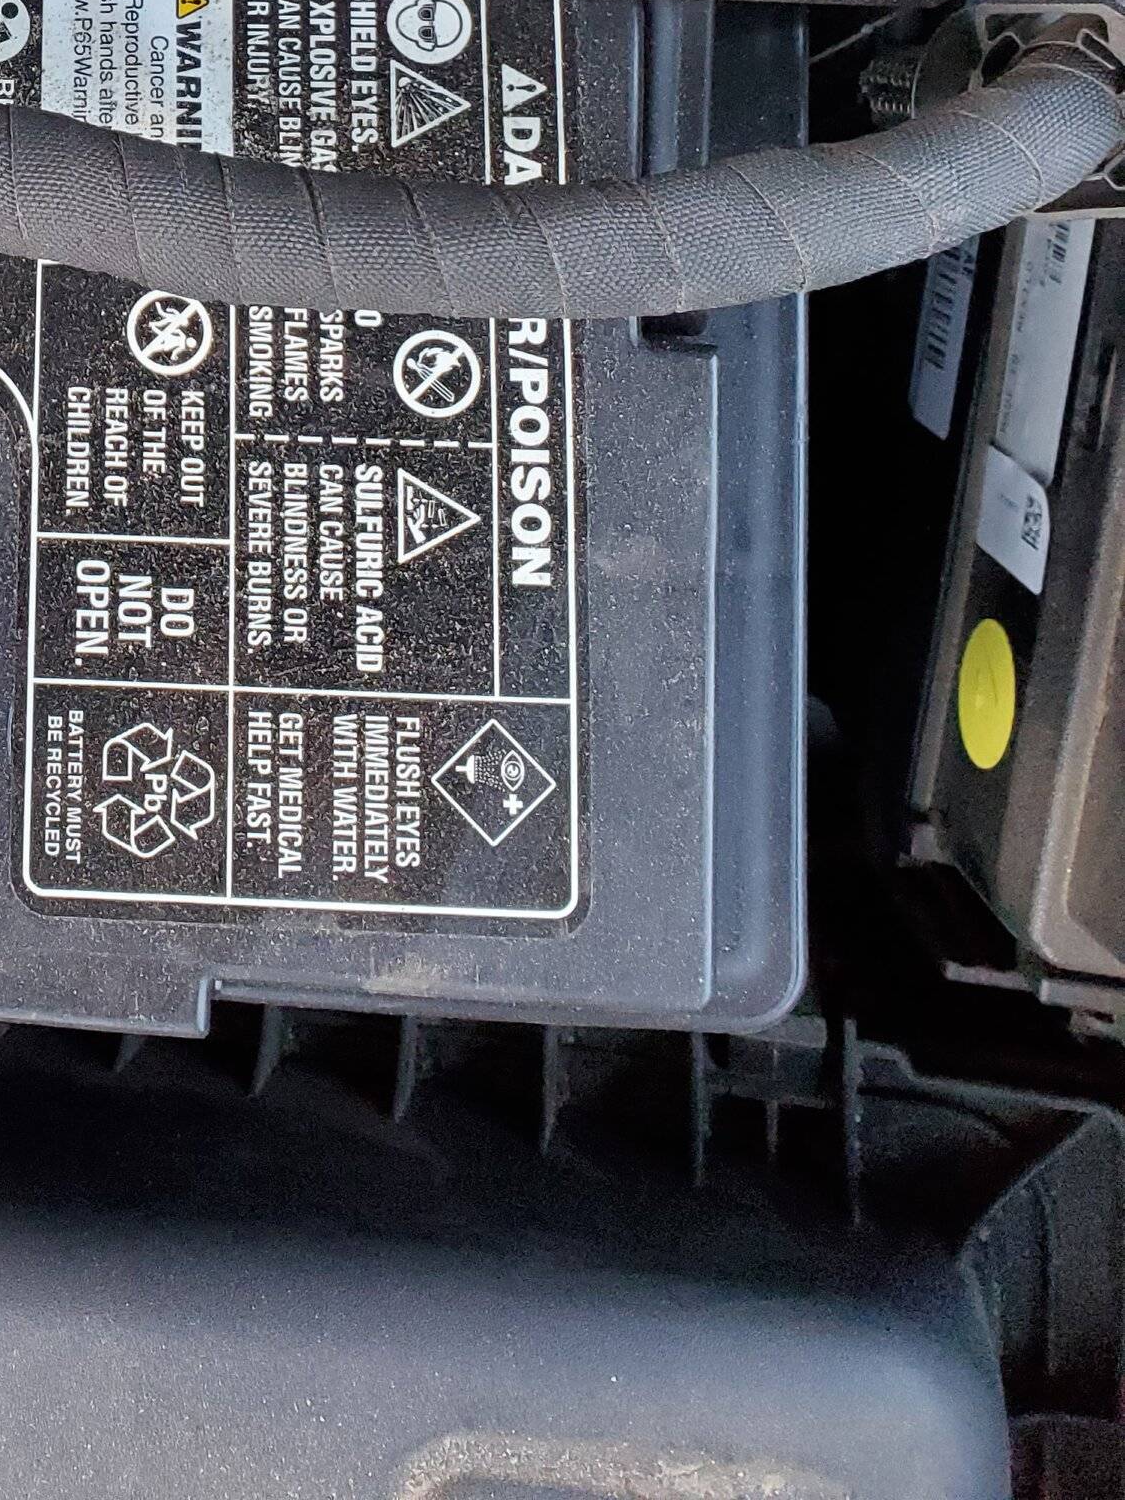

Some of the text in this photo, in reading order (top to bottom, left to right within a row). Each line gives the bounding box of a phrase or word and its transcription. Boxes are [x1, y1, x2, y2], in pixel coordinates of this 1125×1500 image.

[151, 35, 168, 107] Cancer
[278, 37, 301, 108] CAUSE
[352, 80, 378, 152] EYES.
[249, 305, 272, 417] SMOKING
[284, 307, 307, 401] FLAMES
[65, 386, 90, 515] CHILDREN.
[104, 388, 128, 506] REACH OF
[142, 390, 166, 472] OF THE
[180, 391, 204, 508] KEEP OUT
[247, 461, 271, 654] SEVERE BURNS.
[284, 463, 307, 642] BLINDNESS OR
[319, 465, 343, 600] CAN CAUSE
[355, 464, 384, 671] SULFURIC ACID
[75, 560, 109, 666] OPEN.
[118, 575, 152, 647] NOT
[160, 587, 194, 637] DO
[45, 716, 62, 856] BE RECYCLED
[66, 710, 84, 864] BATTERY MUST
[144, 773, 167, 811] Pb
[247, 710, 271, 847] HELP FAST.
[277, 712, 303, 879] GET MEDICAL
[333, 714, 357, 880] WITH WATER.
[364, 715, 389, 883] IMMEDIATELY
[395, 717, 420, 867] FLUSH EYES
